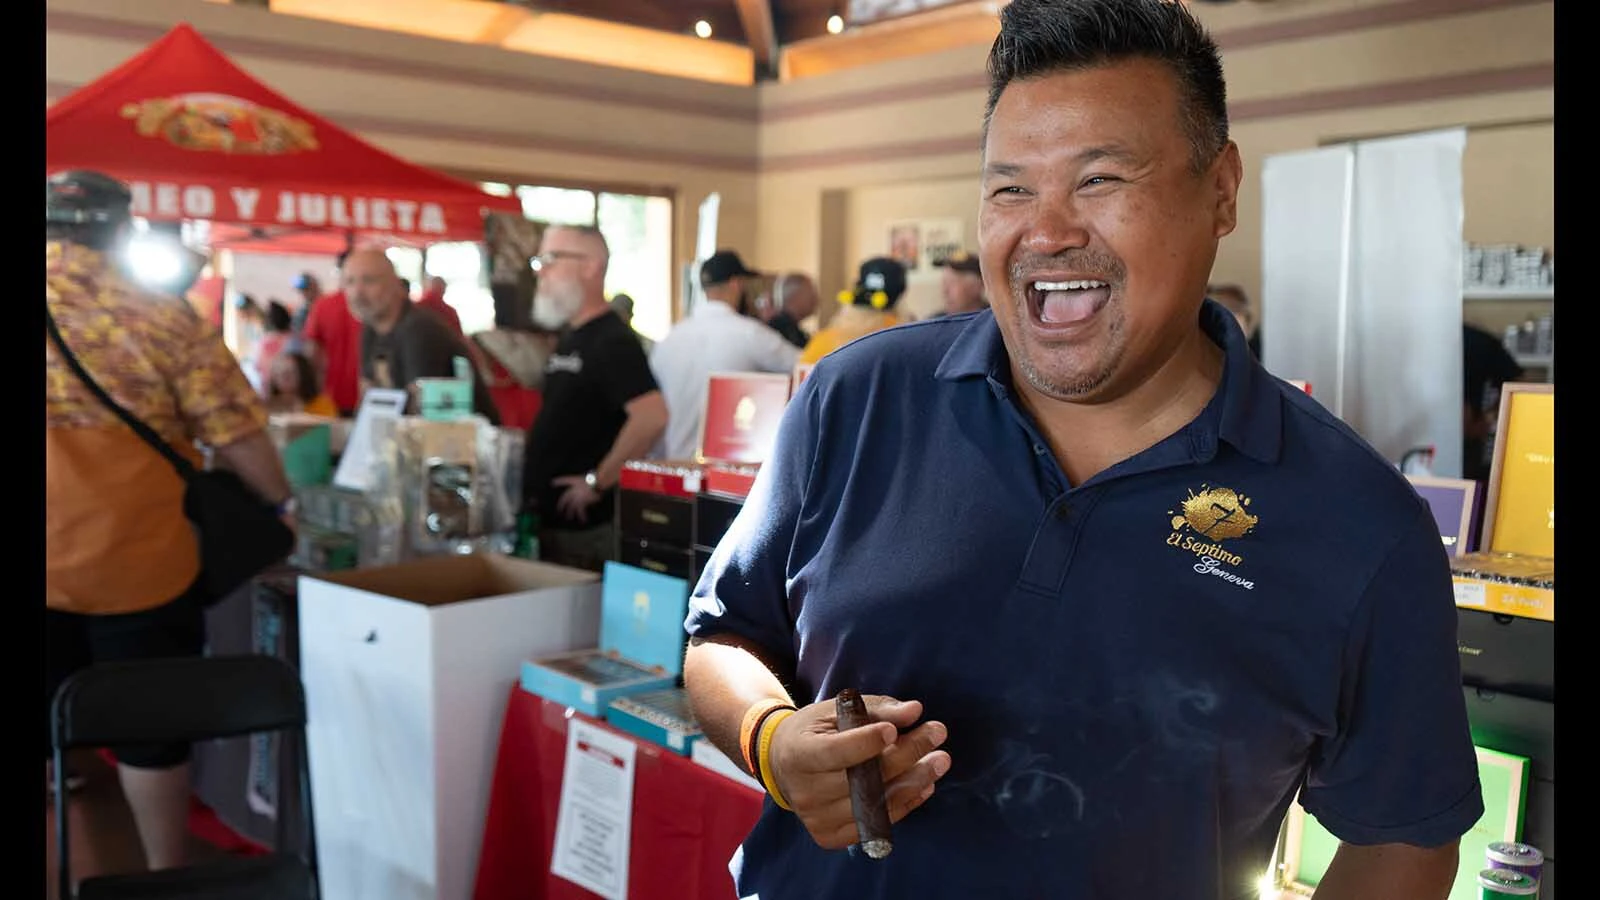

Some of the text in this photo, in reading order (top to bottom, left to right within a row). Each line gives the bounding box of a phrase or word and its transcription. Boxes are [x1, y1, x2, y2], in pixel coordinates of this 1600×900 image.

[230, 187, 258, 220] Y
[277, 191, 446, 233] JULIETA
[1167, 533, 1242, 566] El Septimo
[1193, 556, 1255, 590] Geneva
